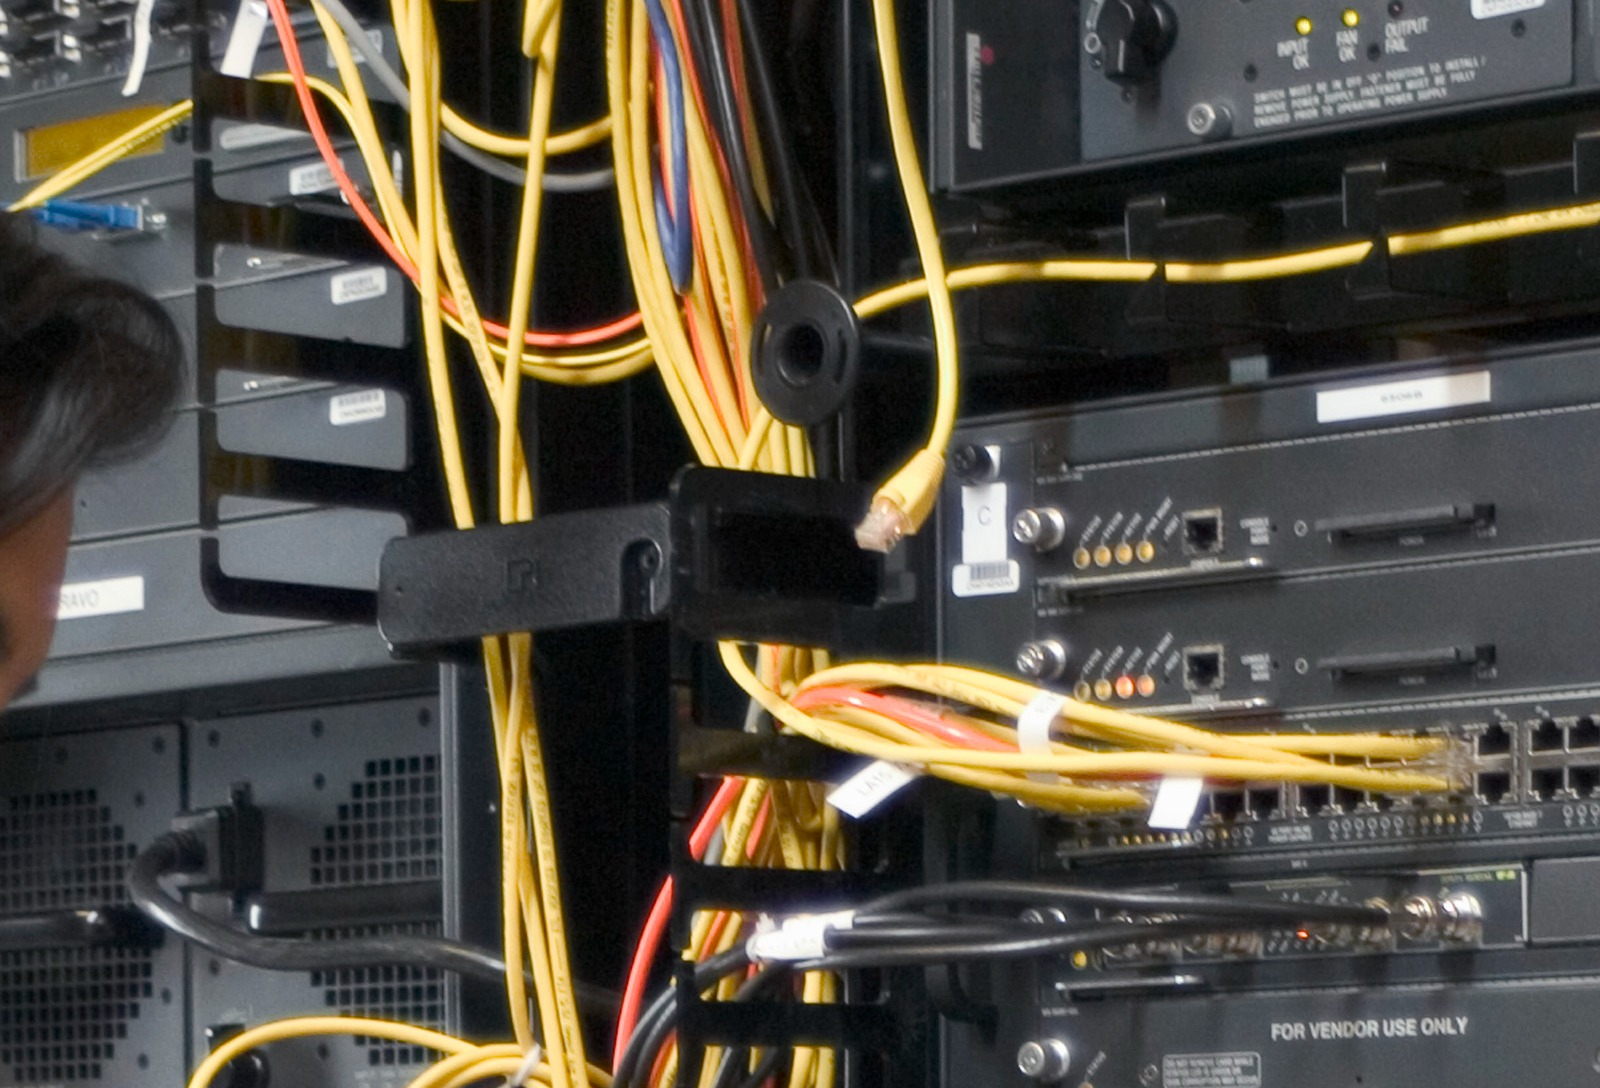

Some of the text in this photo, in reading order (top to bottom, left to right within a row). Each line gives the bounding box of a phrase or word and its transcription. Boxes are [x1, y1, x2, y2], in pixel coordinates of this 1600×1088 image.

[1385, 16, 1429, 38] OUTPUT
[1277, 37, 1309, 58] INPUT
[1336, 30, 1358, 47] FAN
[1271, 1015, 1469, 1041] FOR VENDOR USE ONLY
